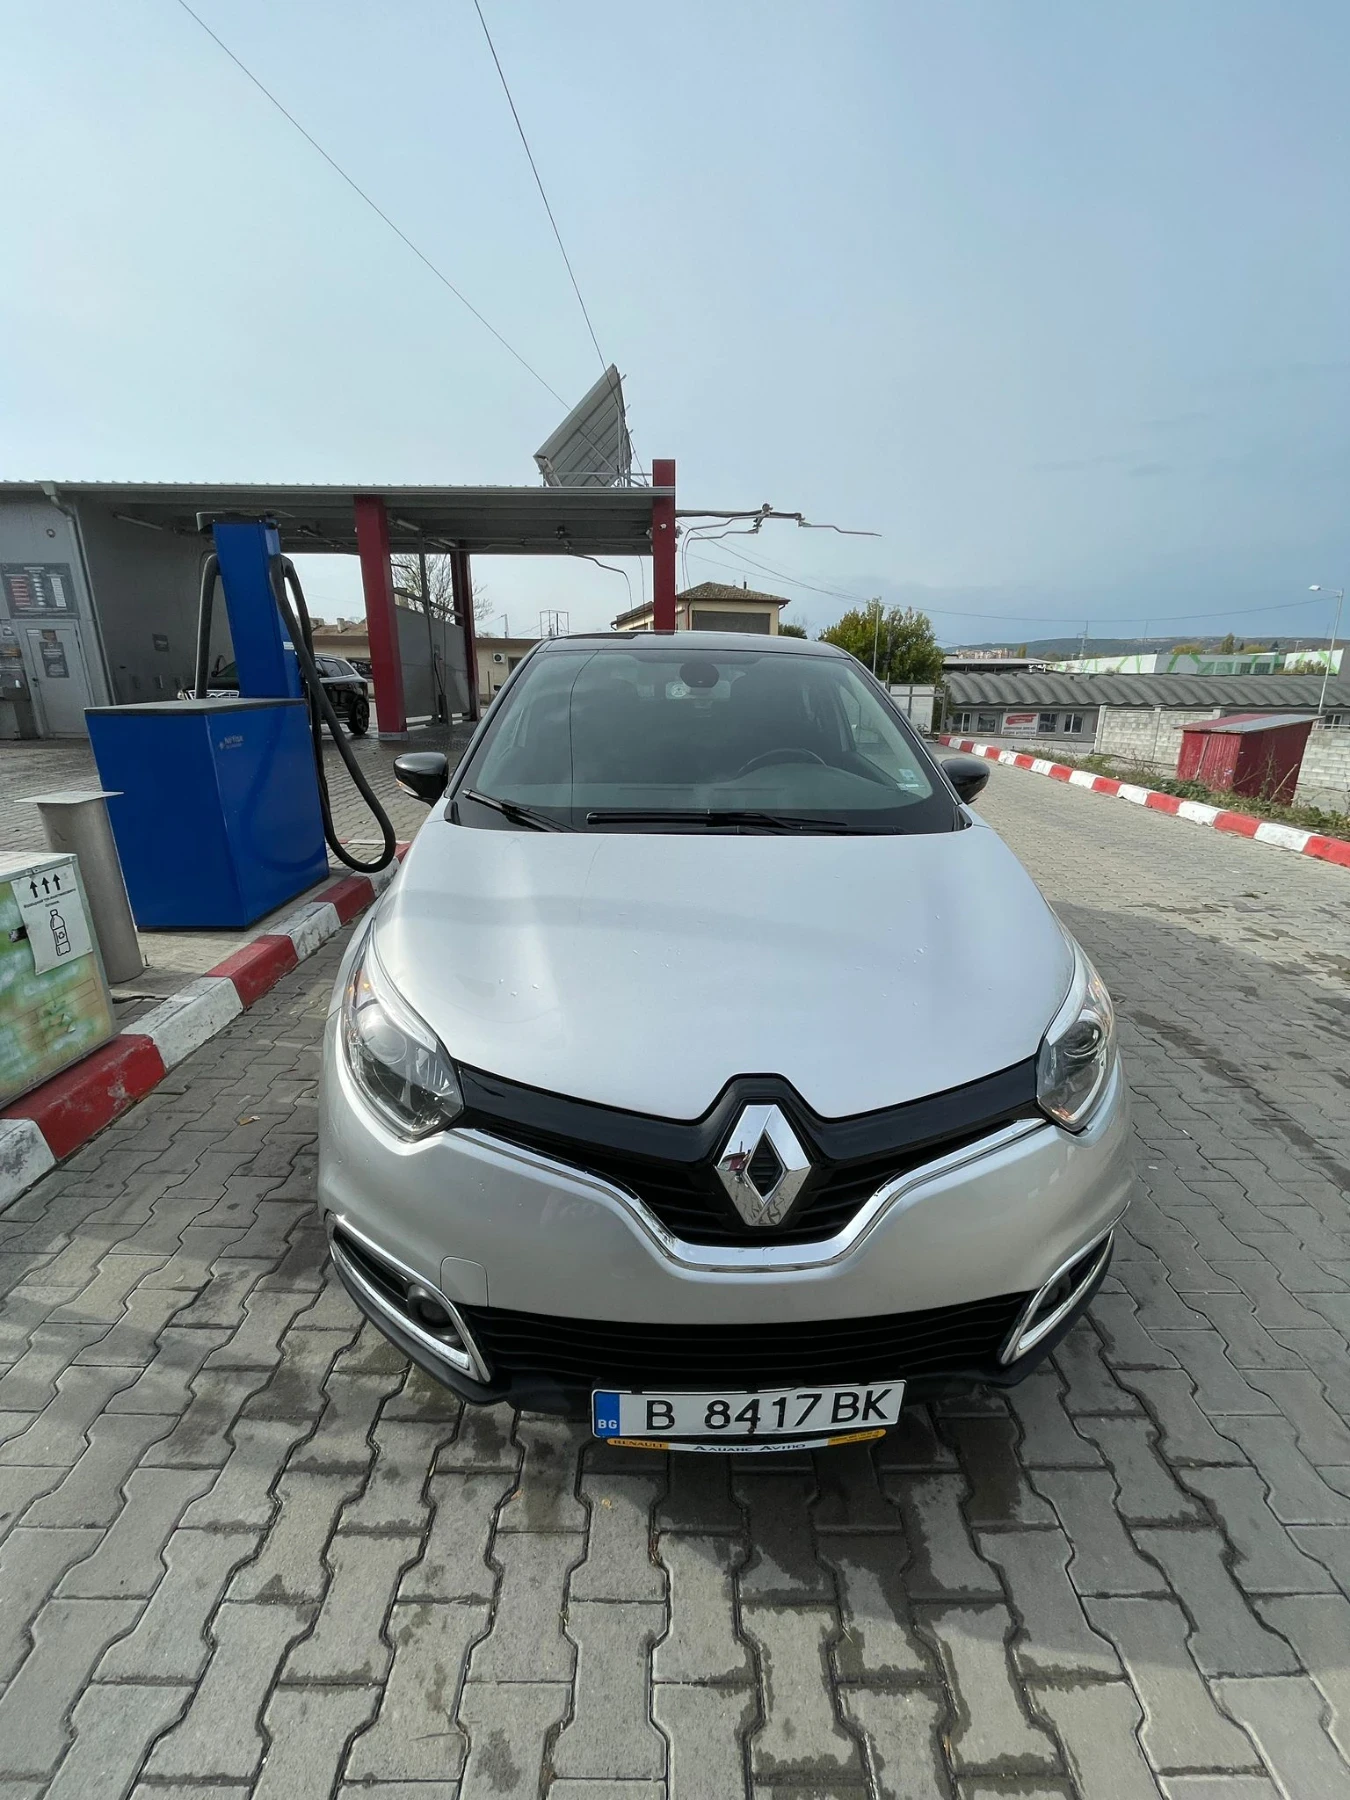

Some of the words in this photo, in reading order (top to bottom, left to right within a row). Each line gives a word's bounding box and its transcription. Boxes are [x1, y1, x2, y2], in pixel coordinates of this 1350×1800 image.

[646, 1399, 676, 1431] B
[597, 1419, 618, 1429] BG
[613, 1439, 664, 1448] RENAULT
